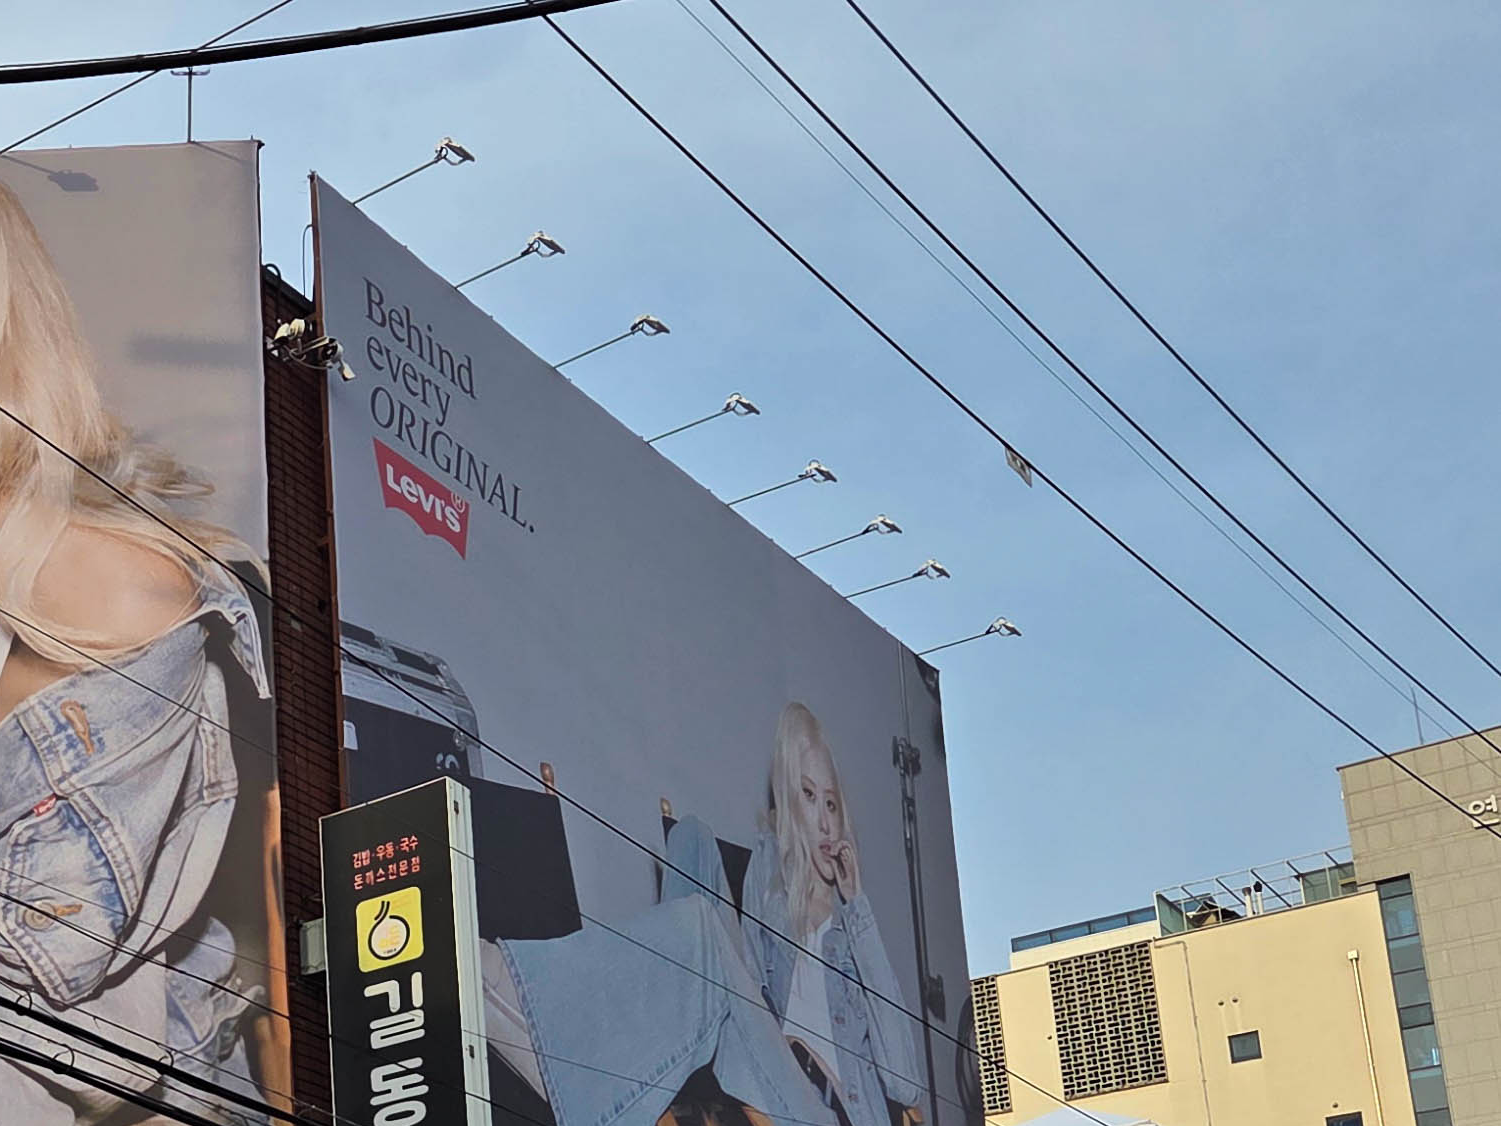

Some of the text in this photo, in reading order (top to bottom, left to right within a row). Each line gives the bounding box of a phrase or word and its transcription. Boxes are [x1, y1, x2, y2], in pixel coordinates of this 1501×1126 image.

[363, 277, 477, 400] Behind
[366, 336, 451, 427] every
[370, 386, 536, 533] ORIGINAL.
